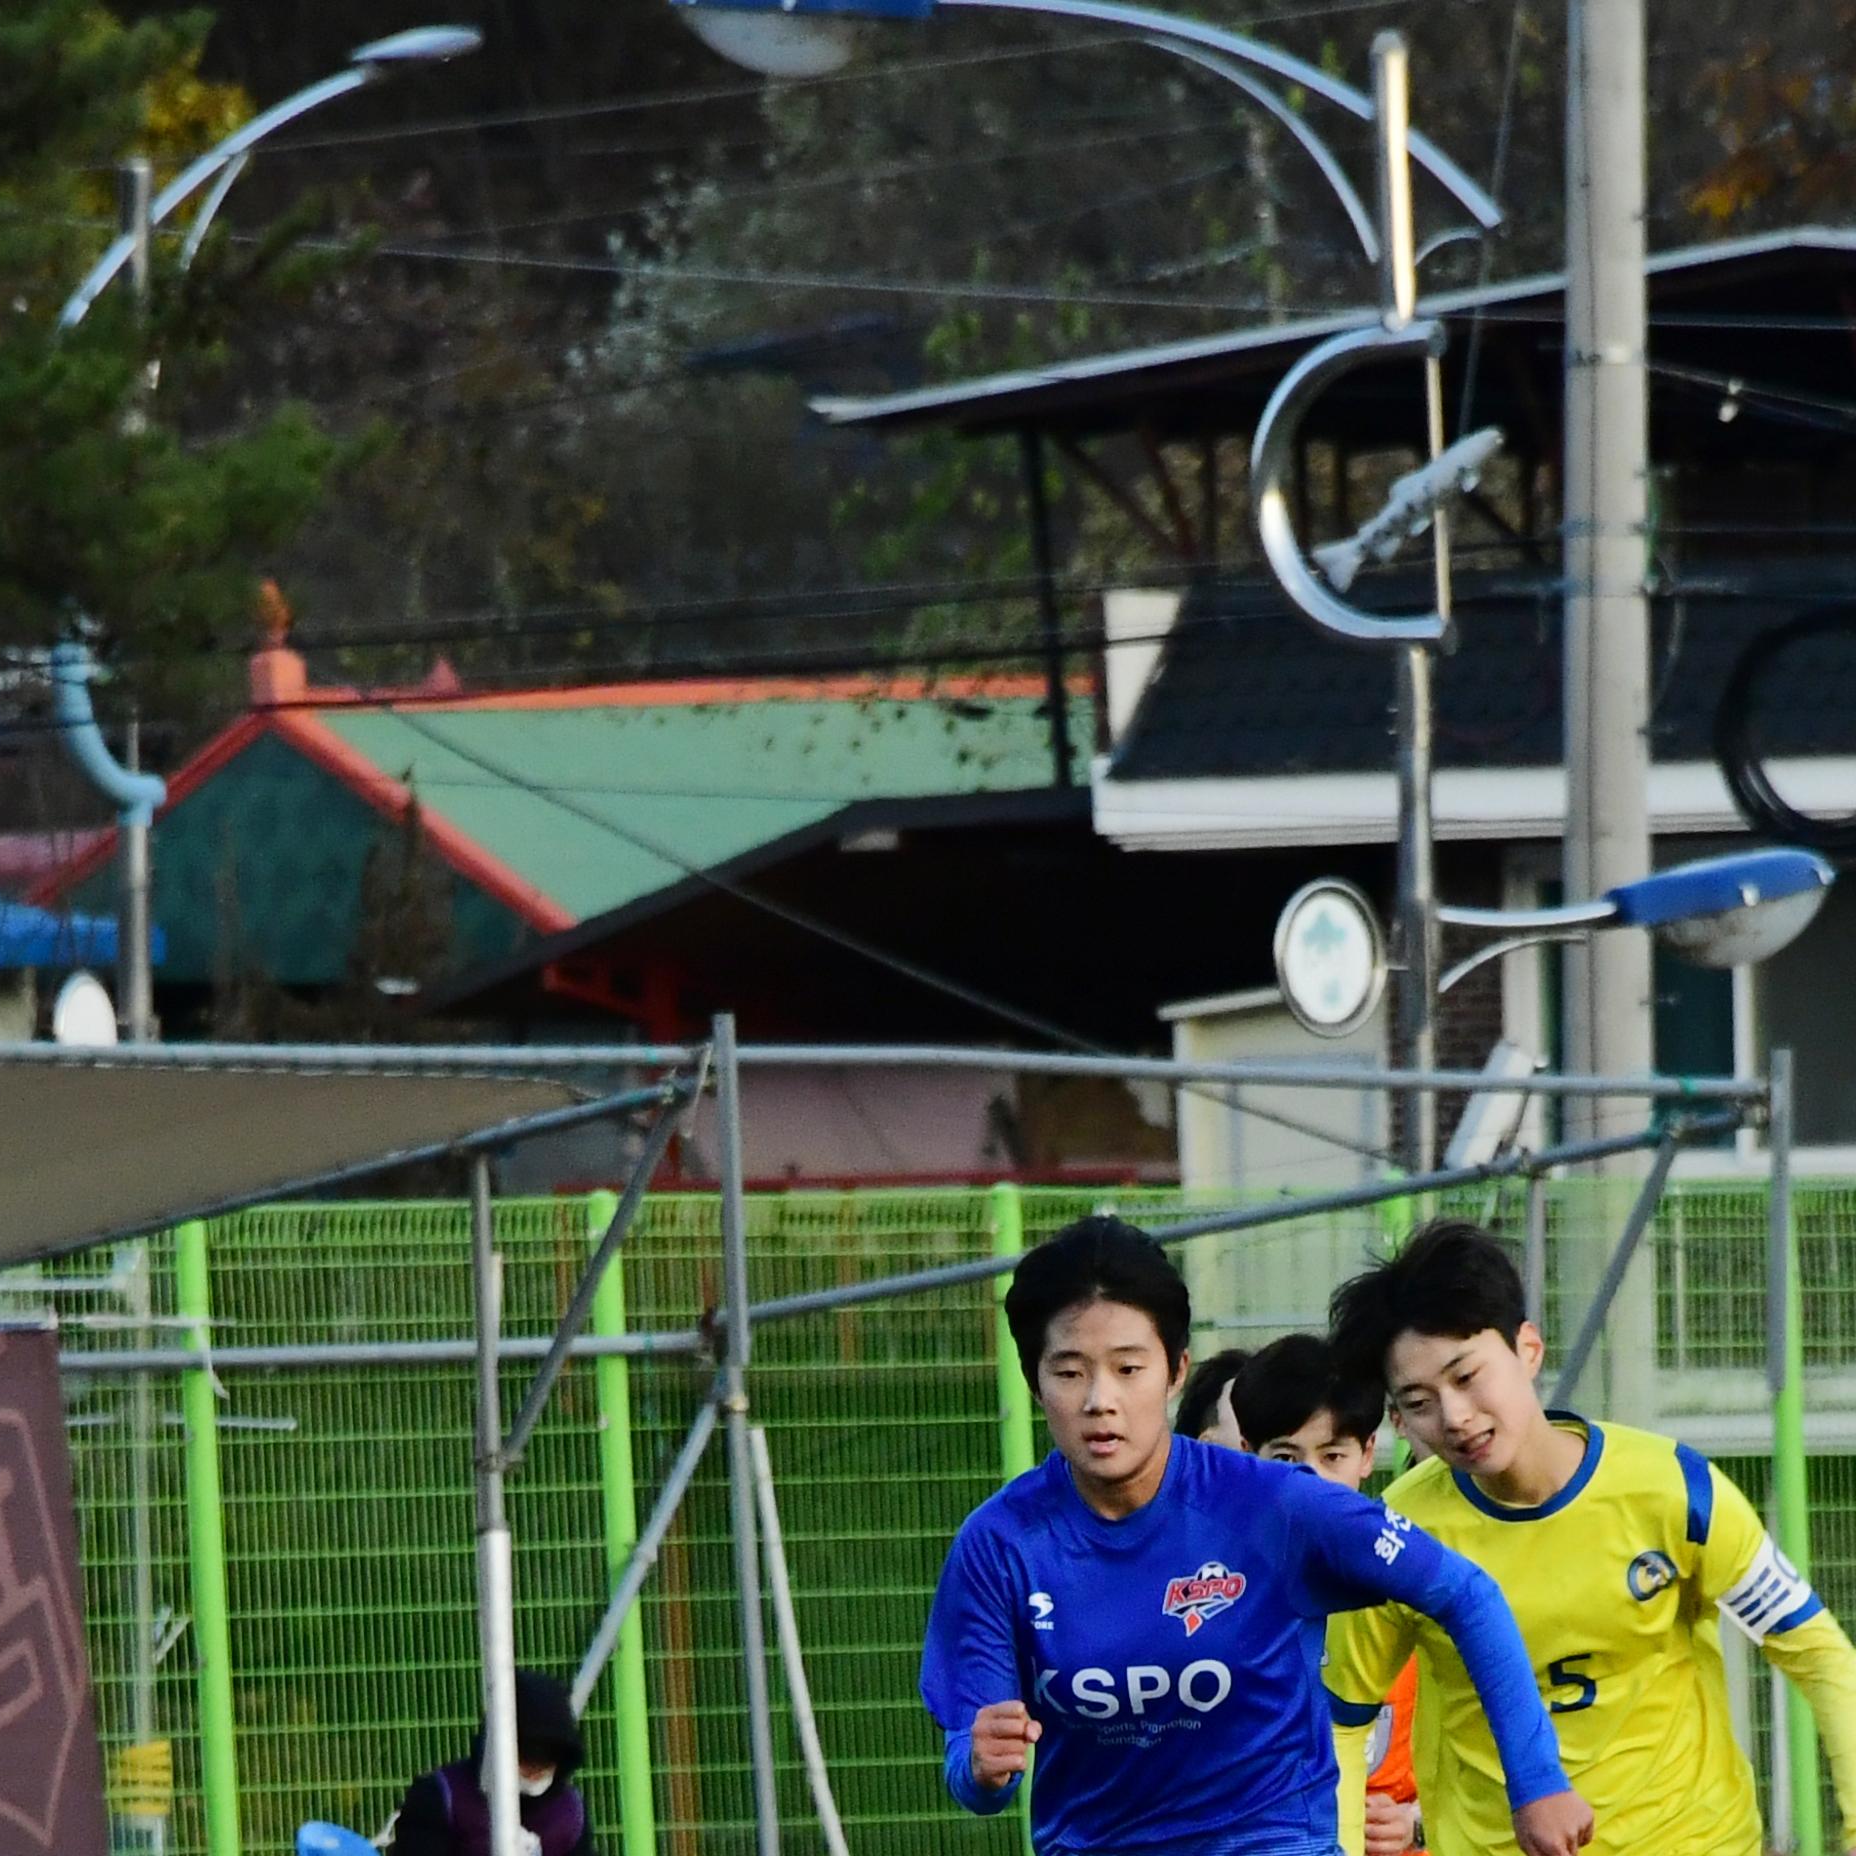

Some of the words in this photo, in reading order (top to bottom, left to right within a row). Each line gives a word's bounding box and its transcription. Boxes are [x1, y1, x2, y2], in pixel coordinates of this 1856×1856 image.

[1165, 1574, 1246, 1610] KSPO
[1030, 1657, 1232, 1719] KSPO
[1548, 1652, 1597, 1713] 5
